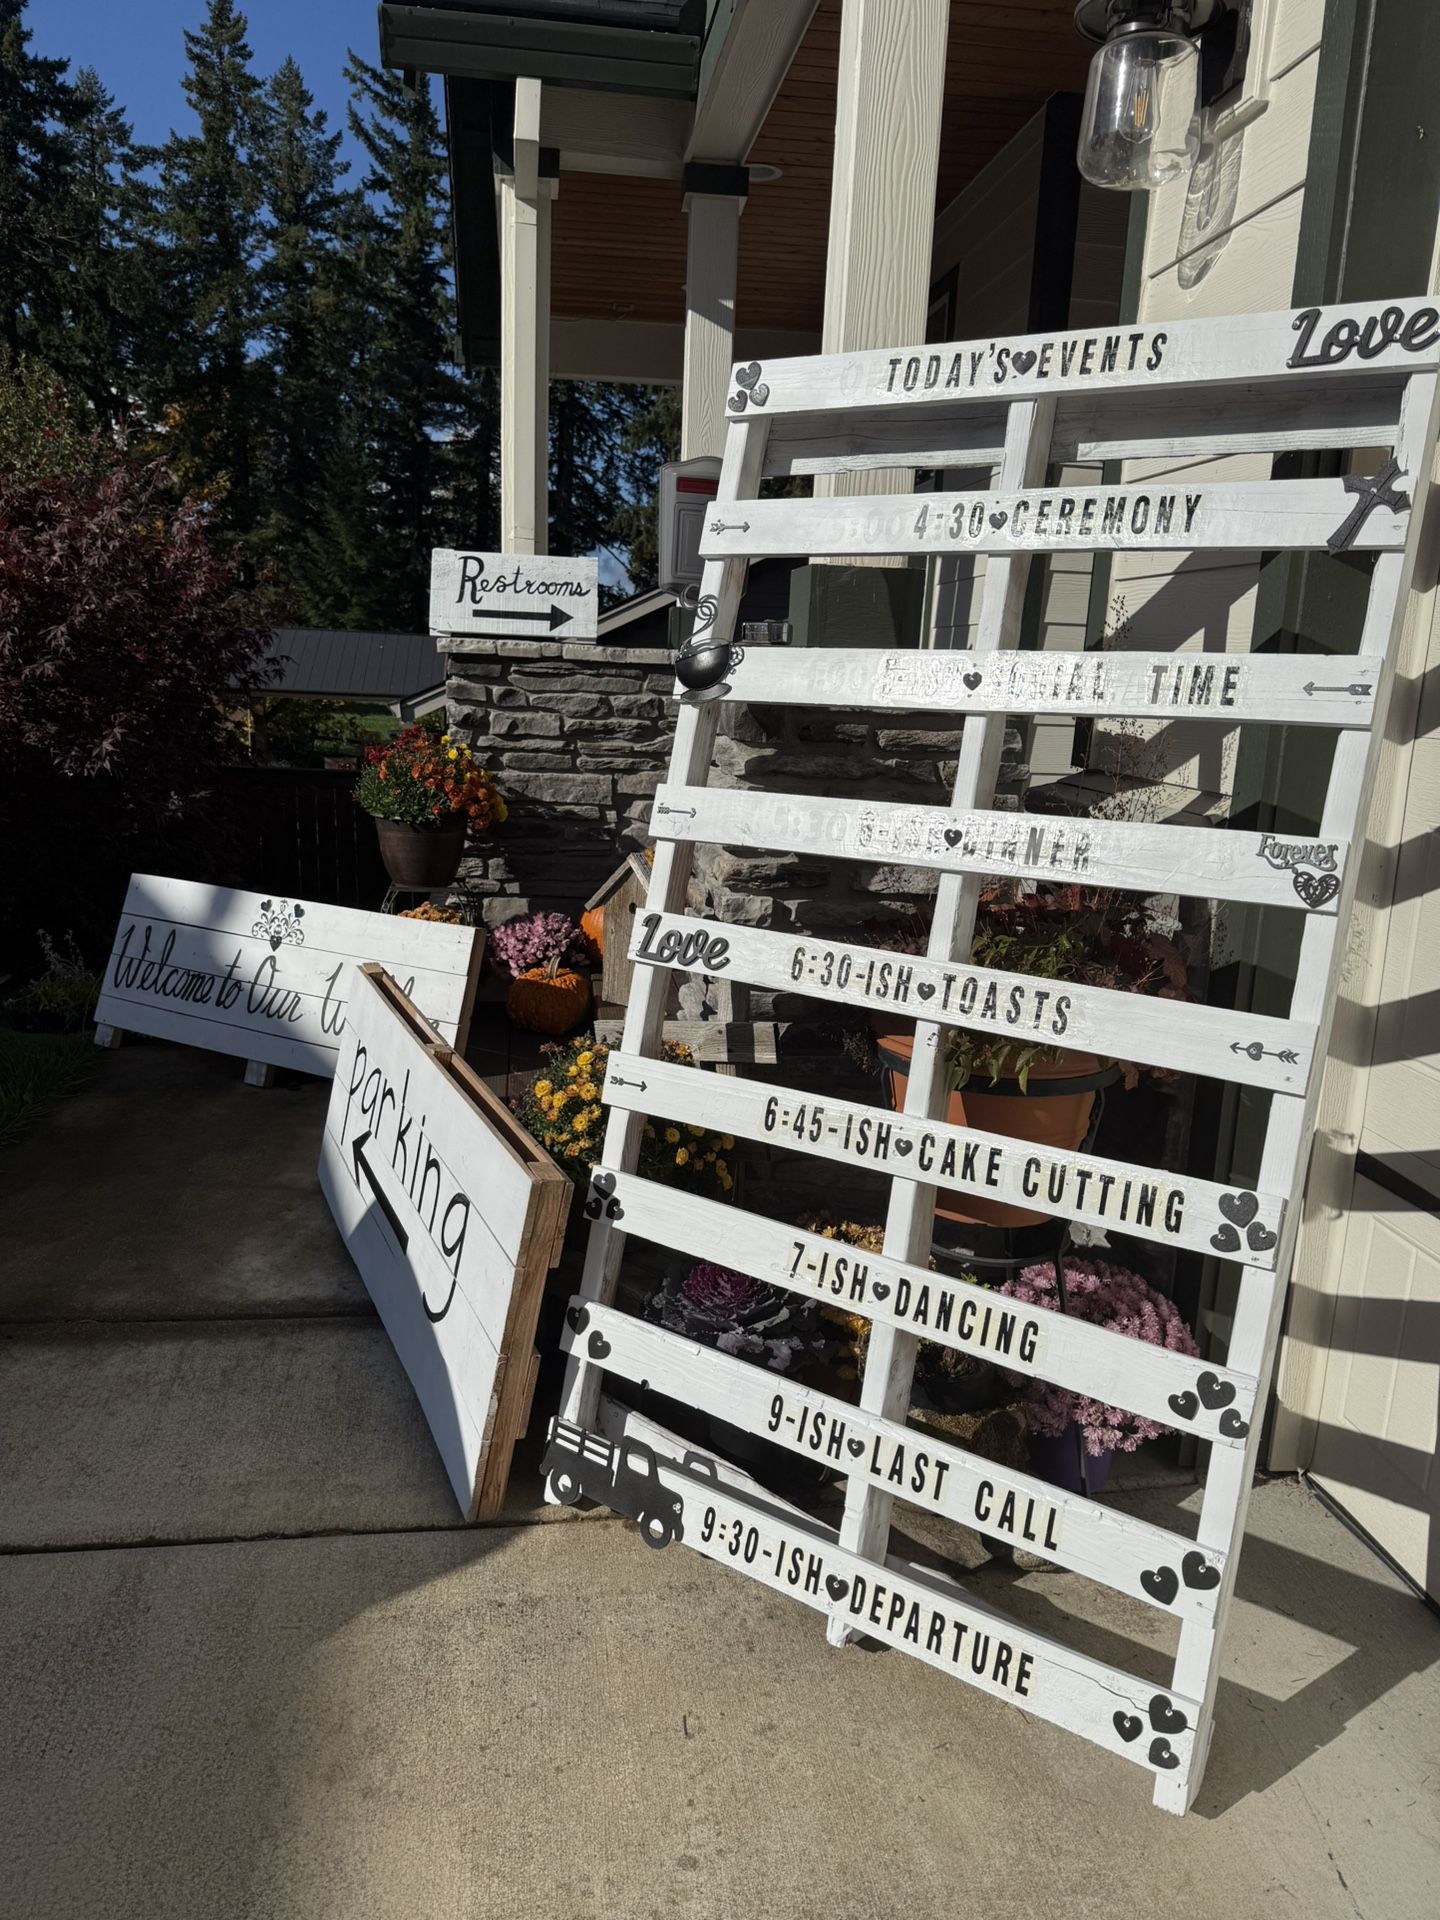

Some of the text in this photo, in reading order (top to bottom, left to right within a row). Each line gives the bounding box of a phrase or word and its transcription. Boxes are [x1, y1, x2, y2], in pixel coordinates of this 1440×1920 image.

[887, 332, 1168, 392] TODAY'S EVENTS
[1286, 306, 1440, 369] Love
[913, 501, 986, 540] 4:30
[1011, 494, 1202, 538] CEREMONY
[455, 556, 591, 604] Restrooms
[1149, 665, 1241, 707] TIME
[1256, 833, 1338, 872] Forever
[113, 924, 214, 1001] Welcome
[214, 948, 245, 1010] to
[246, 955, 305, 1024] Our
[636, 912, 731, 971] Love
[790, 945, 1072, 1036] 6:30-ISH TOASTS
[340, 1038, 471, 1324] parking
[763, 1096, 1187, 1234] 6:45-ISH CAKE CUTTING
[789, 1241, 1039, 1364] 7-ISH DANCING
[768, 1394, 1058, 1551] 9-ISH LAST CALL
[700, 1506, 1035, 1697] 9:30-ISH DEPARTURE
